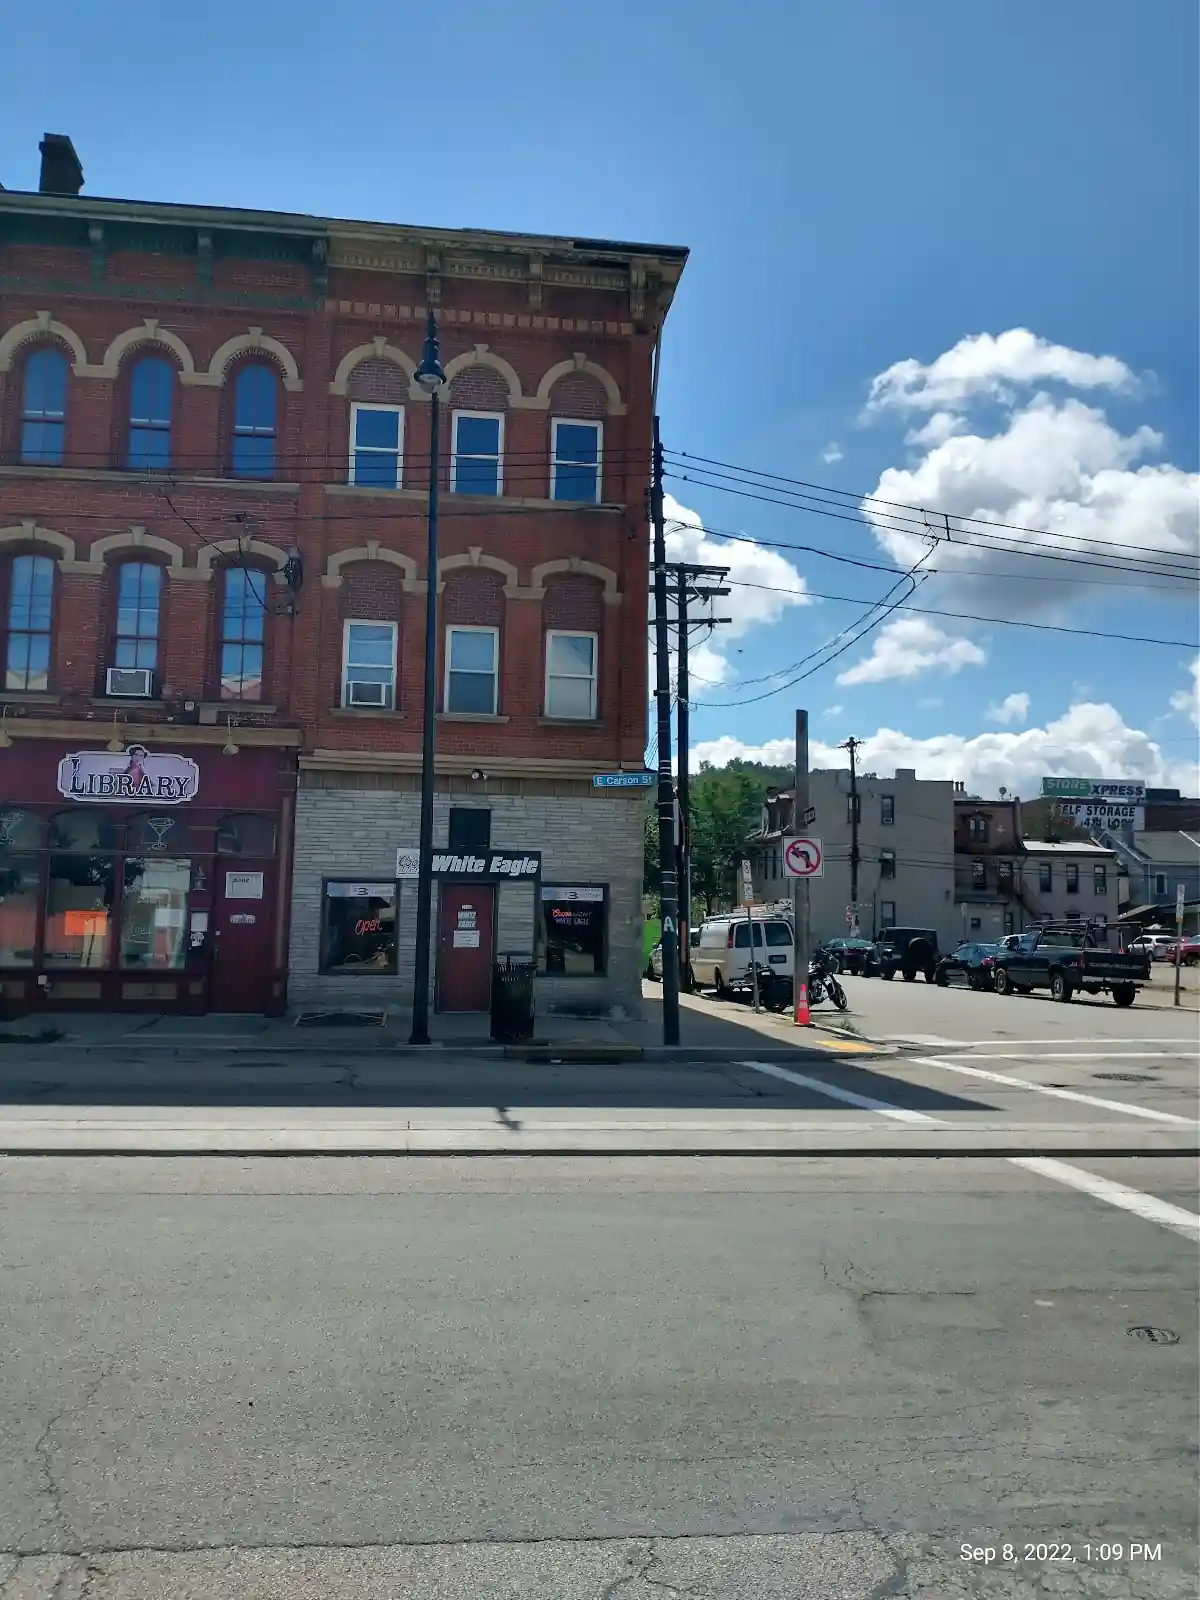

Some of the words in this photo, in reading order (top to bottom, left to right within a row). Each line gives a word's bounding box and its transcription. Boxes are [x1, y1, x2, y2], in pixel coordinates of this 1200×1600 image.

[69, 758, 191, 798] LIBRARY
[596, 776, 604, 785] E
[606, 776, 639, 785] Carson
[642, 775, 653, 784] St
[1091, 784, 1144, 796] XPRESS
[1086, 806, 1136, 817] STORAGE
[431, 854, 486, 873] White
[490, 856, 539, 877] Eagle
[663, 915, 675, 932] A
